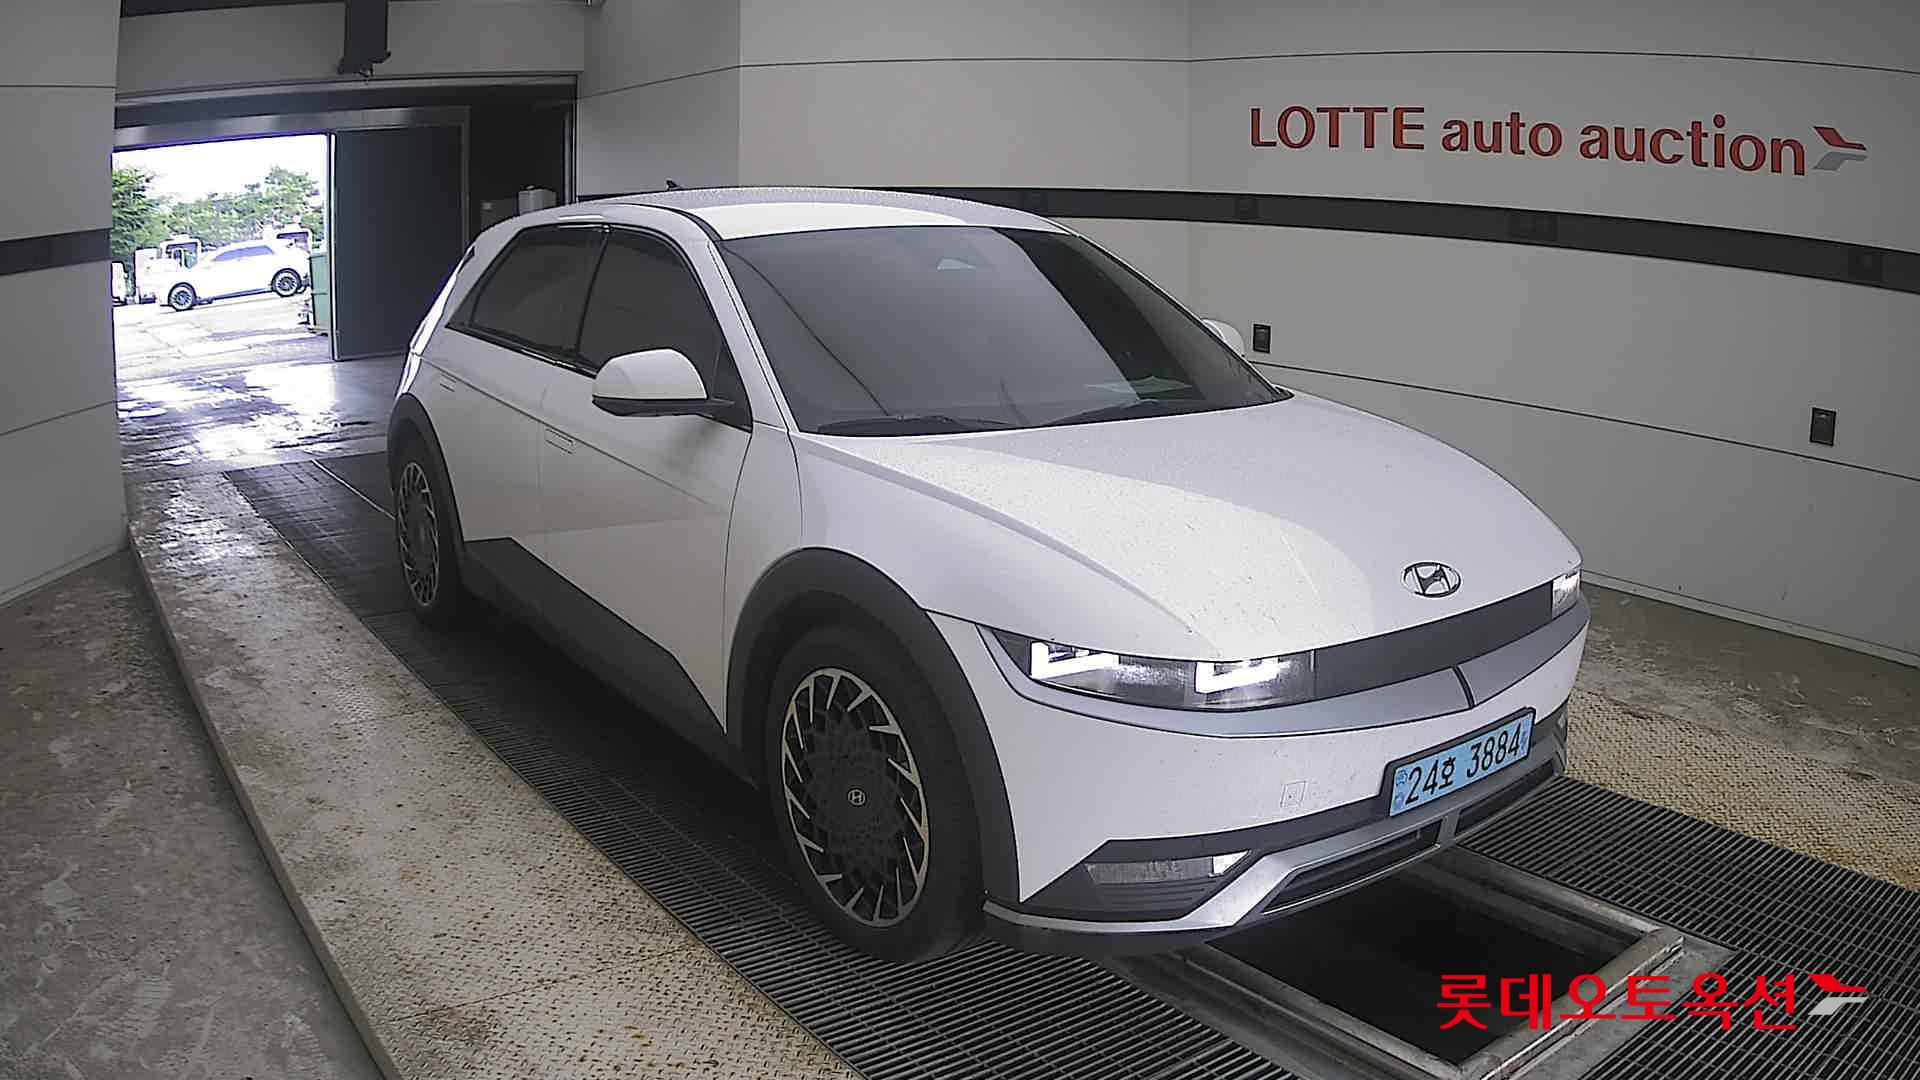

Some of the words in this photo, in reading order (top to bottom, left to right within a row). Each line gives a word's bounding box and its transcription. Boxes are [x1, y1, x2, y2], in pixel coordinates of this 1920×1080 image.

[1250, 106, 1425, 150] LOTTE
[1442, 112, 1563, 157] auto
[1579, 114, 1807, 176] auction
[1405, 757, 1456, 805] 24호
[1467, 723, 1522, 778] 3884
